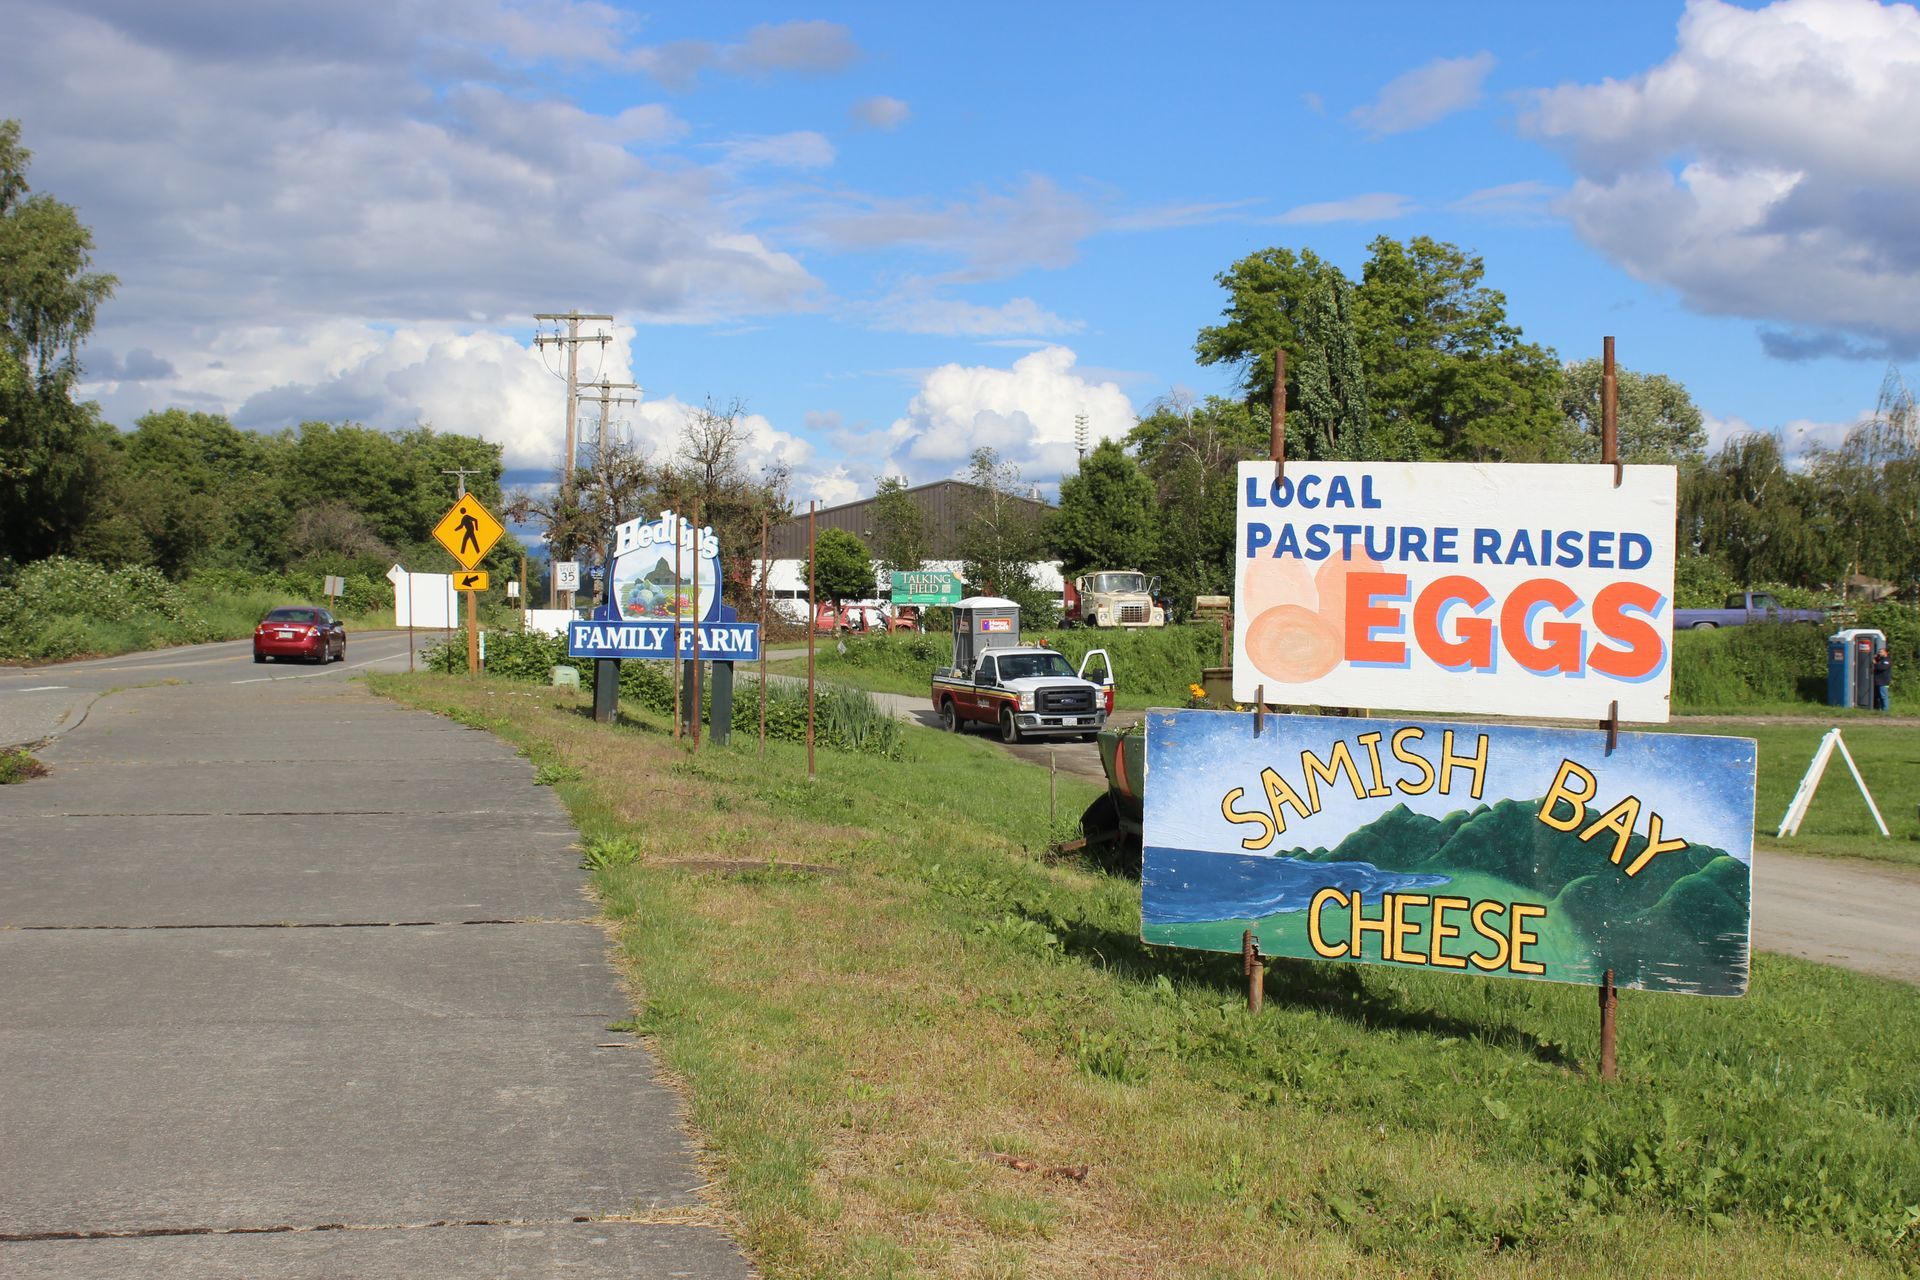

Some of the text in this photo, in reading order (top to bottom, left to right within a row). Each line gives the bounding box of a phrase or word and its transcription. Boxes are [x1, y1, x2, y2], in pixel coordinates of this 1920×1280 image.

[1246, 474, 1382, 509] LOCAL
[1246, 523, 1653, 570] PASTURE RAISED
[561, 571, 575, 582] 35
[901, 572, 951, 584] TALKING
[908, 583, 940, 594] FIELD
[574, 626, 753, 652] FAMILY FARM
[1344, 572, 1668, 683] EGGS
[1221, 727, 1688, 878] SAMISH BAY
[1307, 888, 1548, 975] CHEESE
